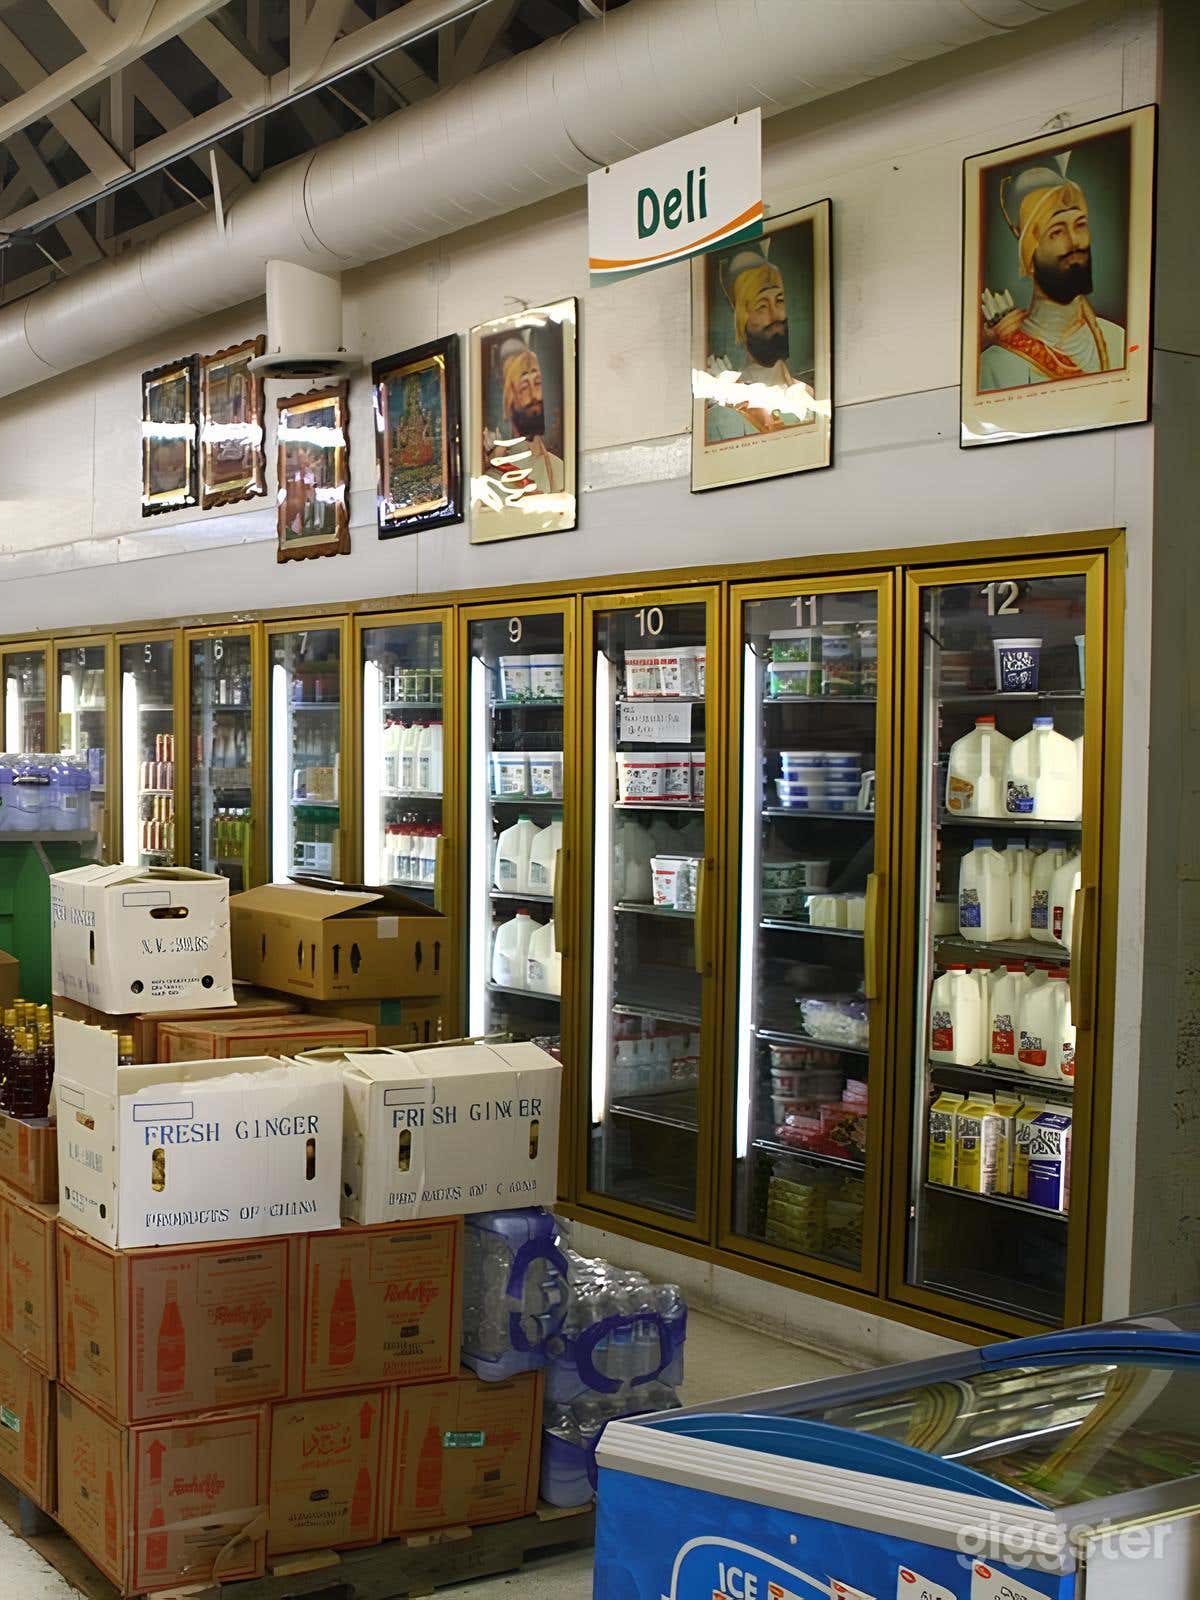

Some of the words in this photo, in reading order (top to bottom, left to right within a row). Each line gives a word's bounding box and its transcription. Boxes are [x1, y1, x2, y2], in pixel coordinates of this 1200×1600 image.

[637, 166, 707, 239] Deli
[790, 595, 817, 627] 11
[981, 581, 1019, 616] 12
[508, 616, 522, 643] 9
[634, 607, 664, 637] 10
[144, 645, 152, 663] 5
[214, 640, 224, 660] 6
[144, 1122, 220, 1146] FRESH
[235, 1115, 319, 1140] GINGER
[718, 1561, 758, 1600] ICE
